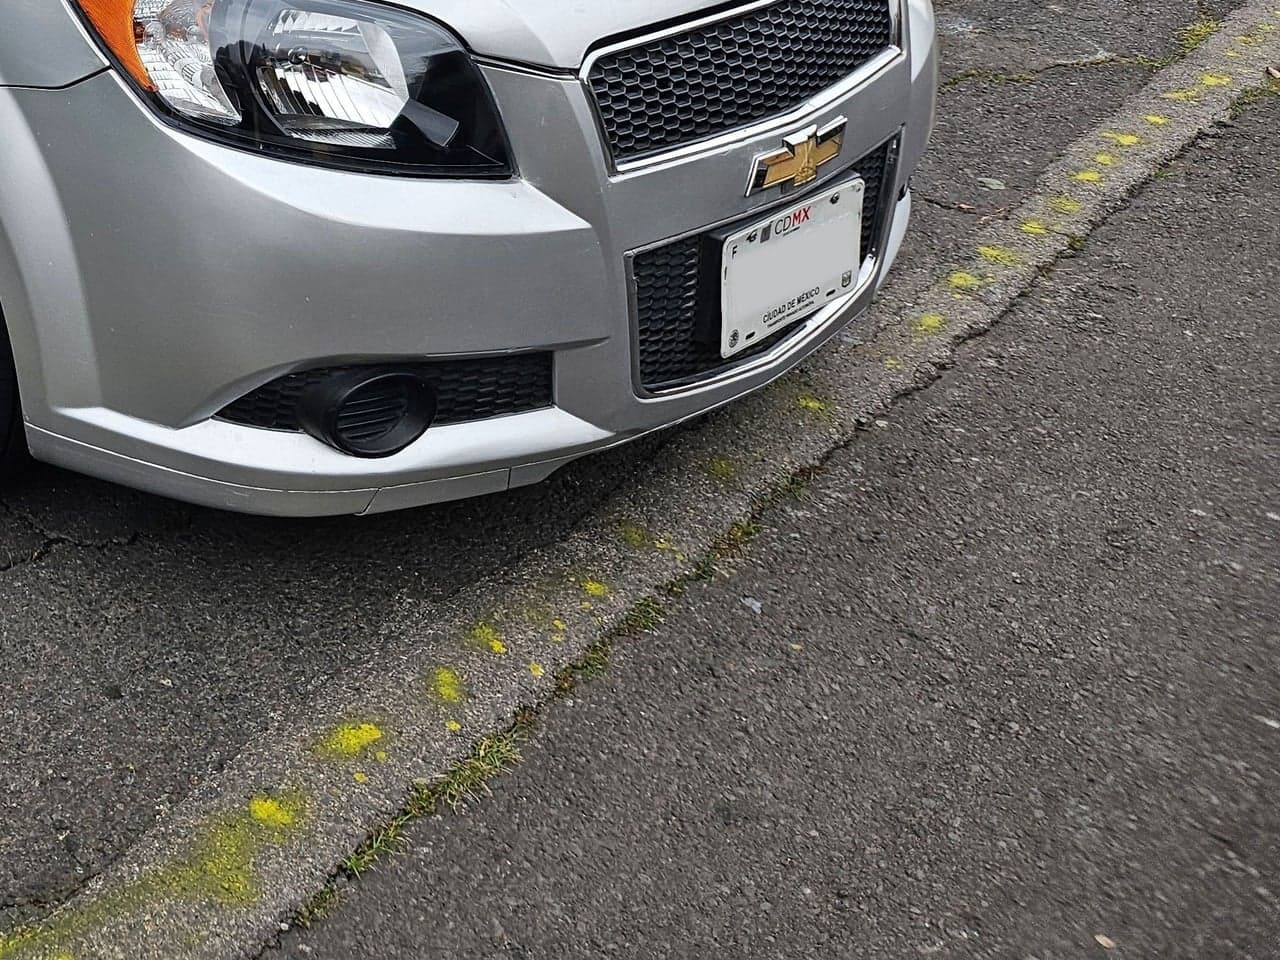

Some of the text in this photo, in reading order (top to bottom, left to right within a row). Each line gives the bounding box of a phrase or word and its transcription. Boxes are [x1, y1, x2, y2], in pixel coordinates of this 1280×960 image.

[775, 206, 812, 235] CDMX
[762, 304, 786, 323] CIUDAD
[787, 299, 796, 310] DE
[796, 286, 820, 305] MÉXICO
